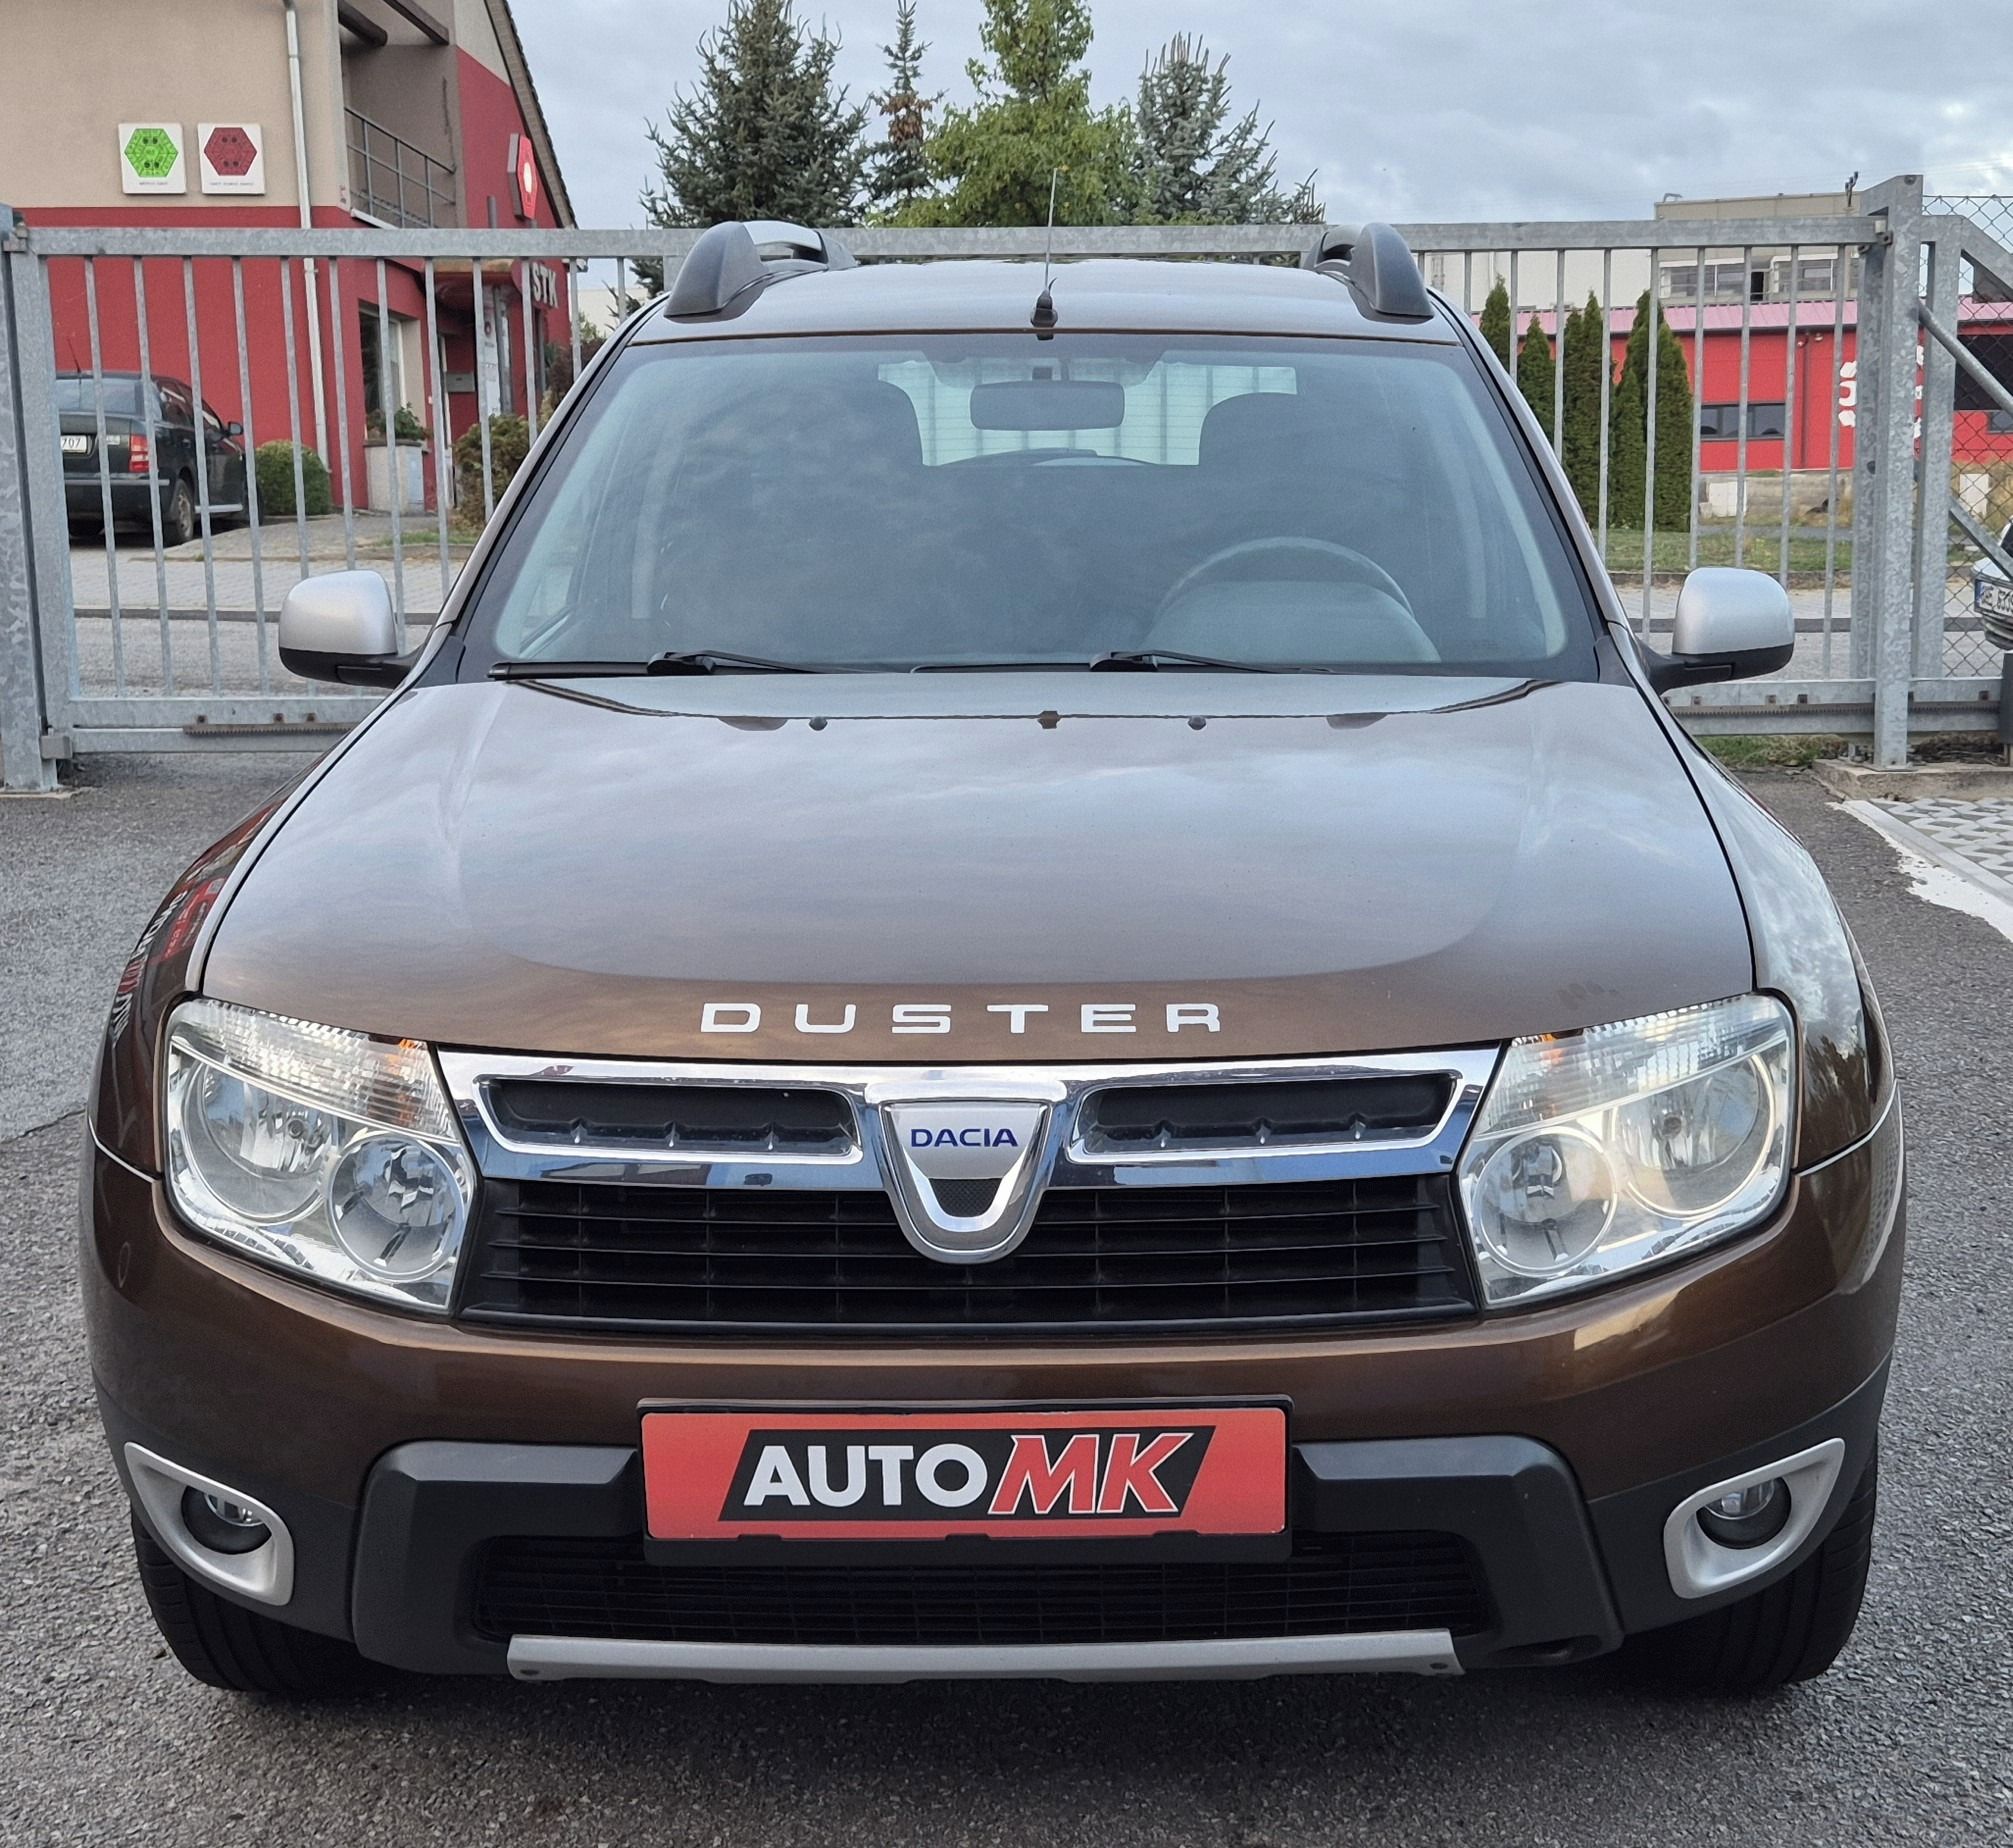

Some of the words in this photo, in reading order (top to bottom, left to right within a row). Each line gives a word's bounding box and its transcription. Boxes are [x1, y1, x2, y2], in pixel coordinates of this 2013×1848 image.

[531, 262, 559, 309] STK
[700, 1002, 1221, 1034] DUSTER
[910, 1127, 1018, 1148] DACIA
